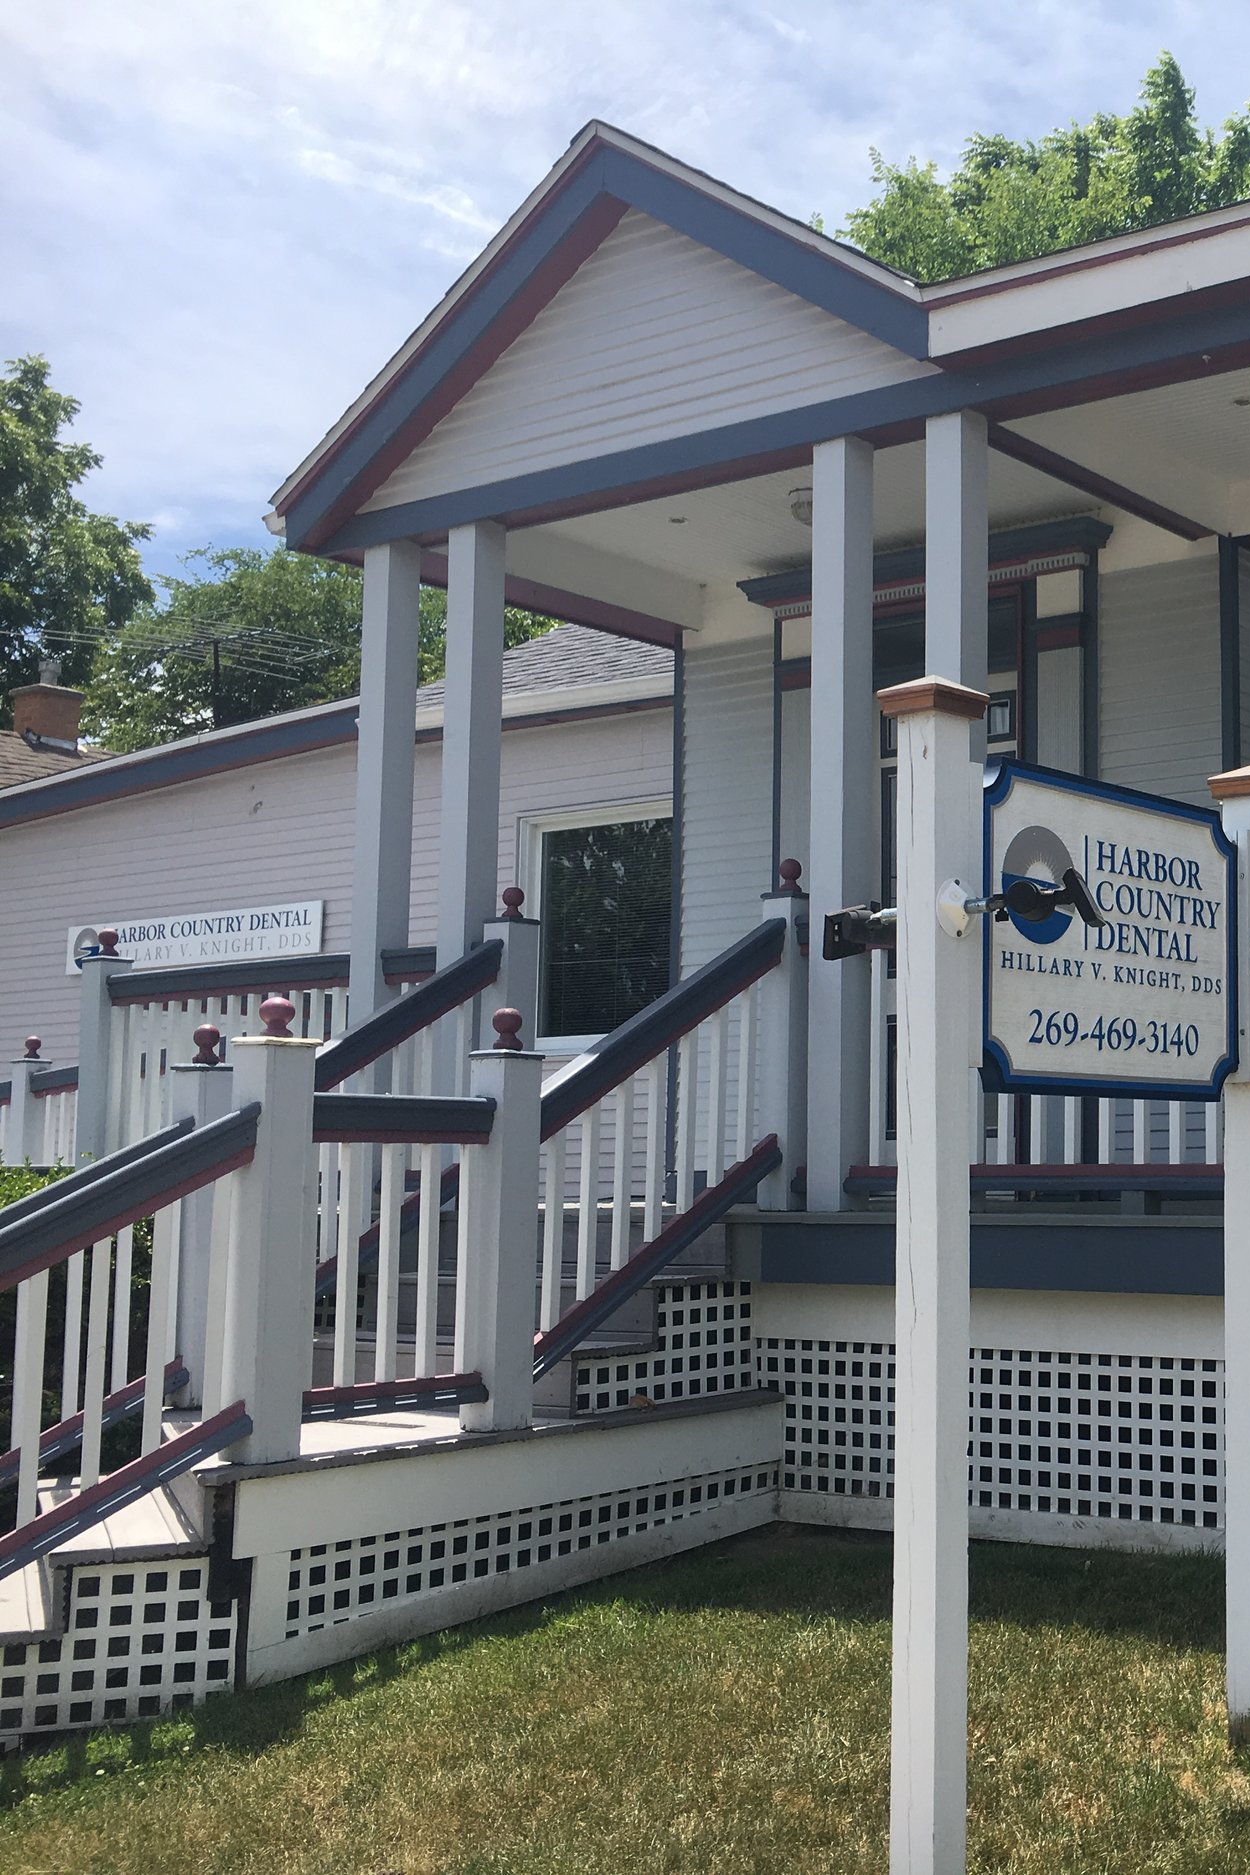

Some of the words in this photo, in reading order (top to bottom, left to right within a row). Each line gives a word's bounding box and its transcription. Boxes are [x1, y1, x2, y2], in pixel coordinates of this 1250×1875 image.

[1096, 840, 1203, 891] HARBOR
[109, 923, 167, 944] ARBOR
[170, 914, 246, 939] COUNTRY
[249, 909, 312, 931] DENTAL
[1095, 880, 1221, 930] COUNTRY
[180, 942, 192, 957] V.
[200, 936, 271, 956] KNIGHT,
[279, 931, 312, 949] DDS
[1095, 919, 1198, 963] DENTAL
[1001, 950, 1084, 978] HILLARY
[1091, 962, 1107, 981] V.
[1113, 966, 1186, 993] KNIGHT,
[1192, 975, 1222, 995] DDS
[1028, 1008, 1199, 1058] 269-469-3140
